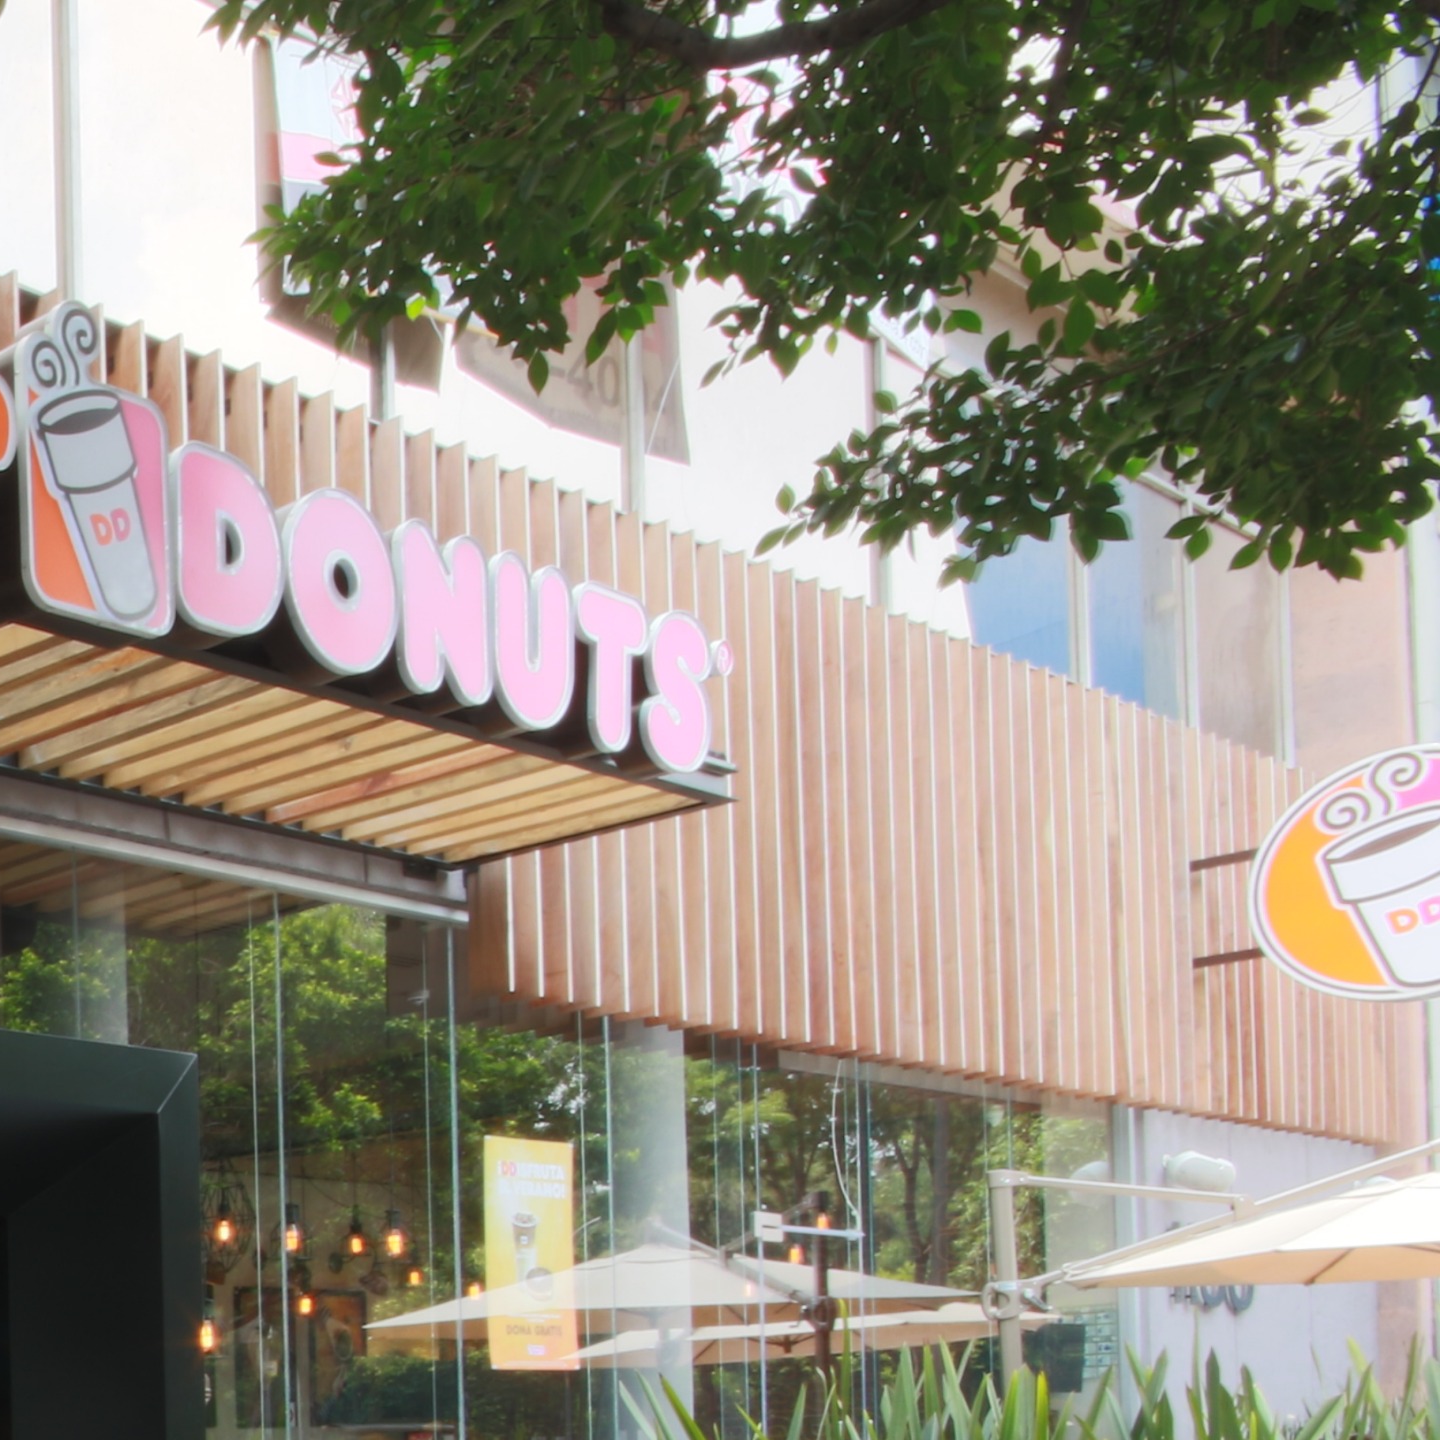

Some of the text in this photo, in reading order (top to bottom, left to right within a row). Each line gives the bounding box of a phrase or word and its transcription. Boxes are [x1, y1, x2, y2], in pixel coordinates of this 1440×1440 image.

[90, 508, 131, 546] DD
[174, 441, 712, 772] DONUTS
[1384, 895, 1440, 935] DD
